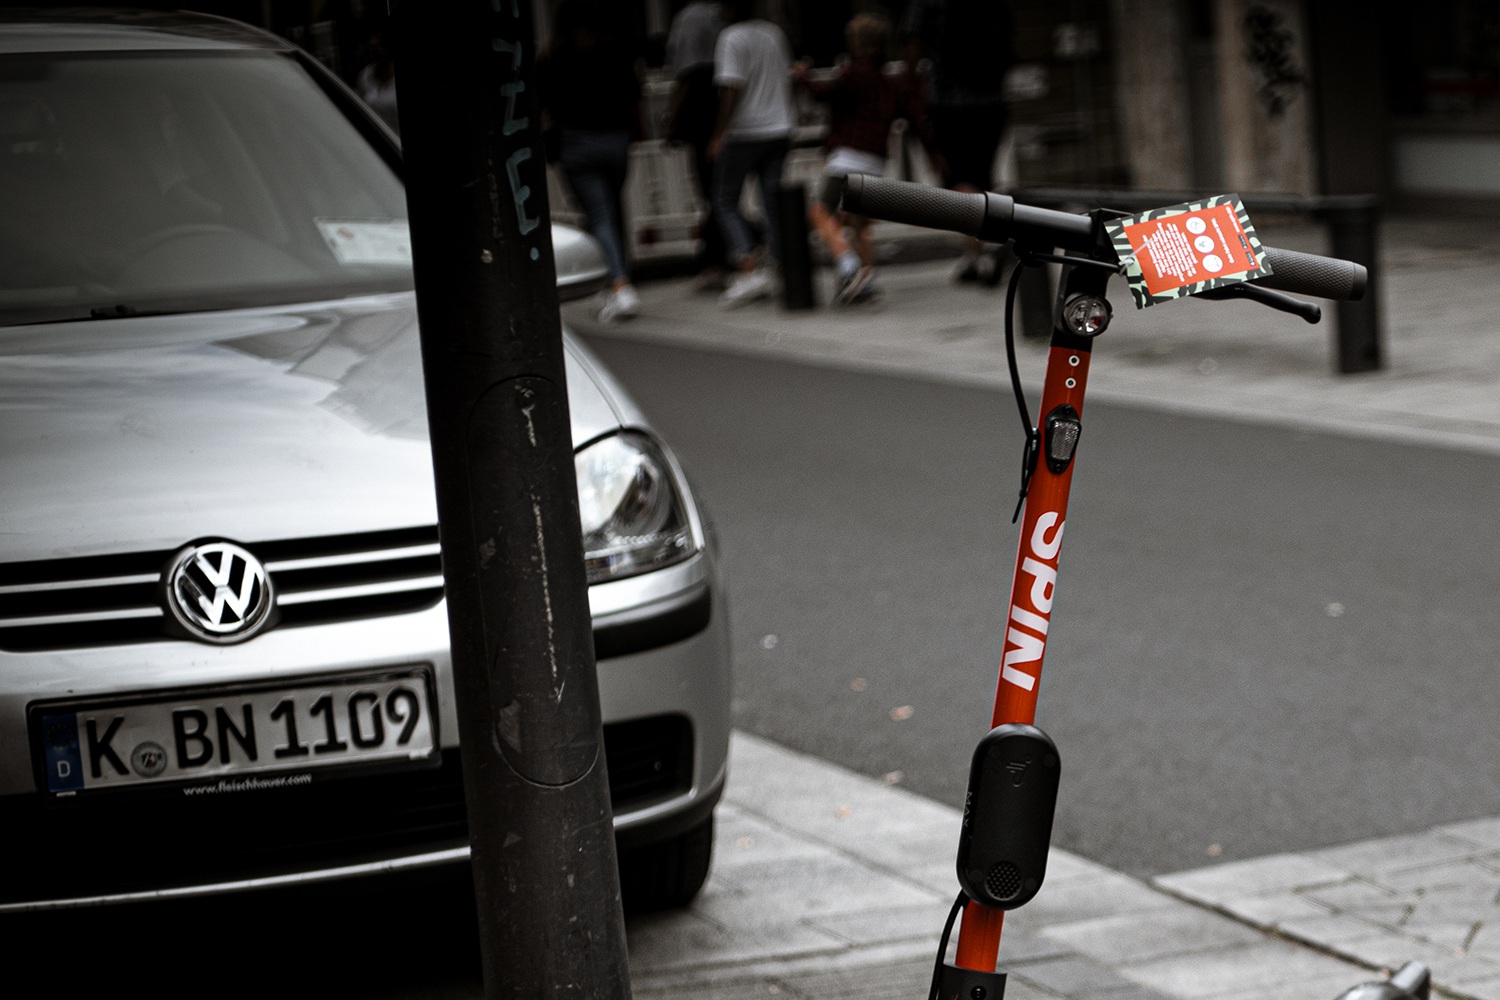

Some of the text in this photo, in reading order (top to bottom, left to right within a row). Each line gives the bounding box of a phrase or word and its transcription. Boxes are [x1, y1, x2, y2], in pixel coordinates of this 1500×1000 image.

[172, 543, 268, 635] VW
[1002, 511, 1066, 692] SPIN
[57, 760, 71, 778] D
[86, 715, 130, 779] K
[270, 686, 421, 759] 1109
